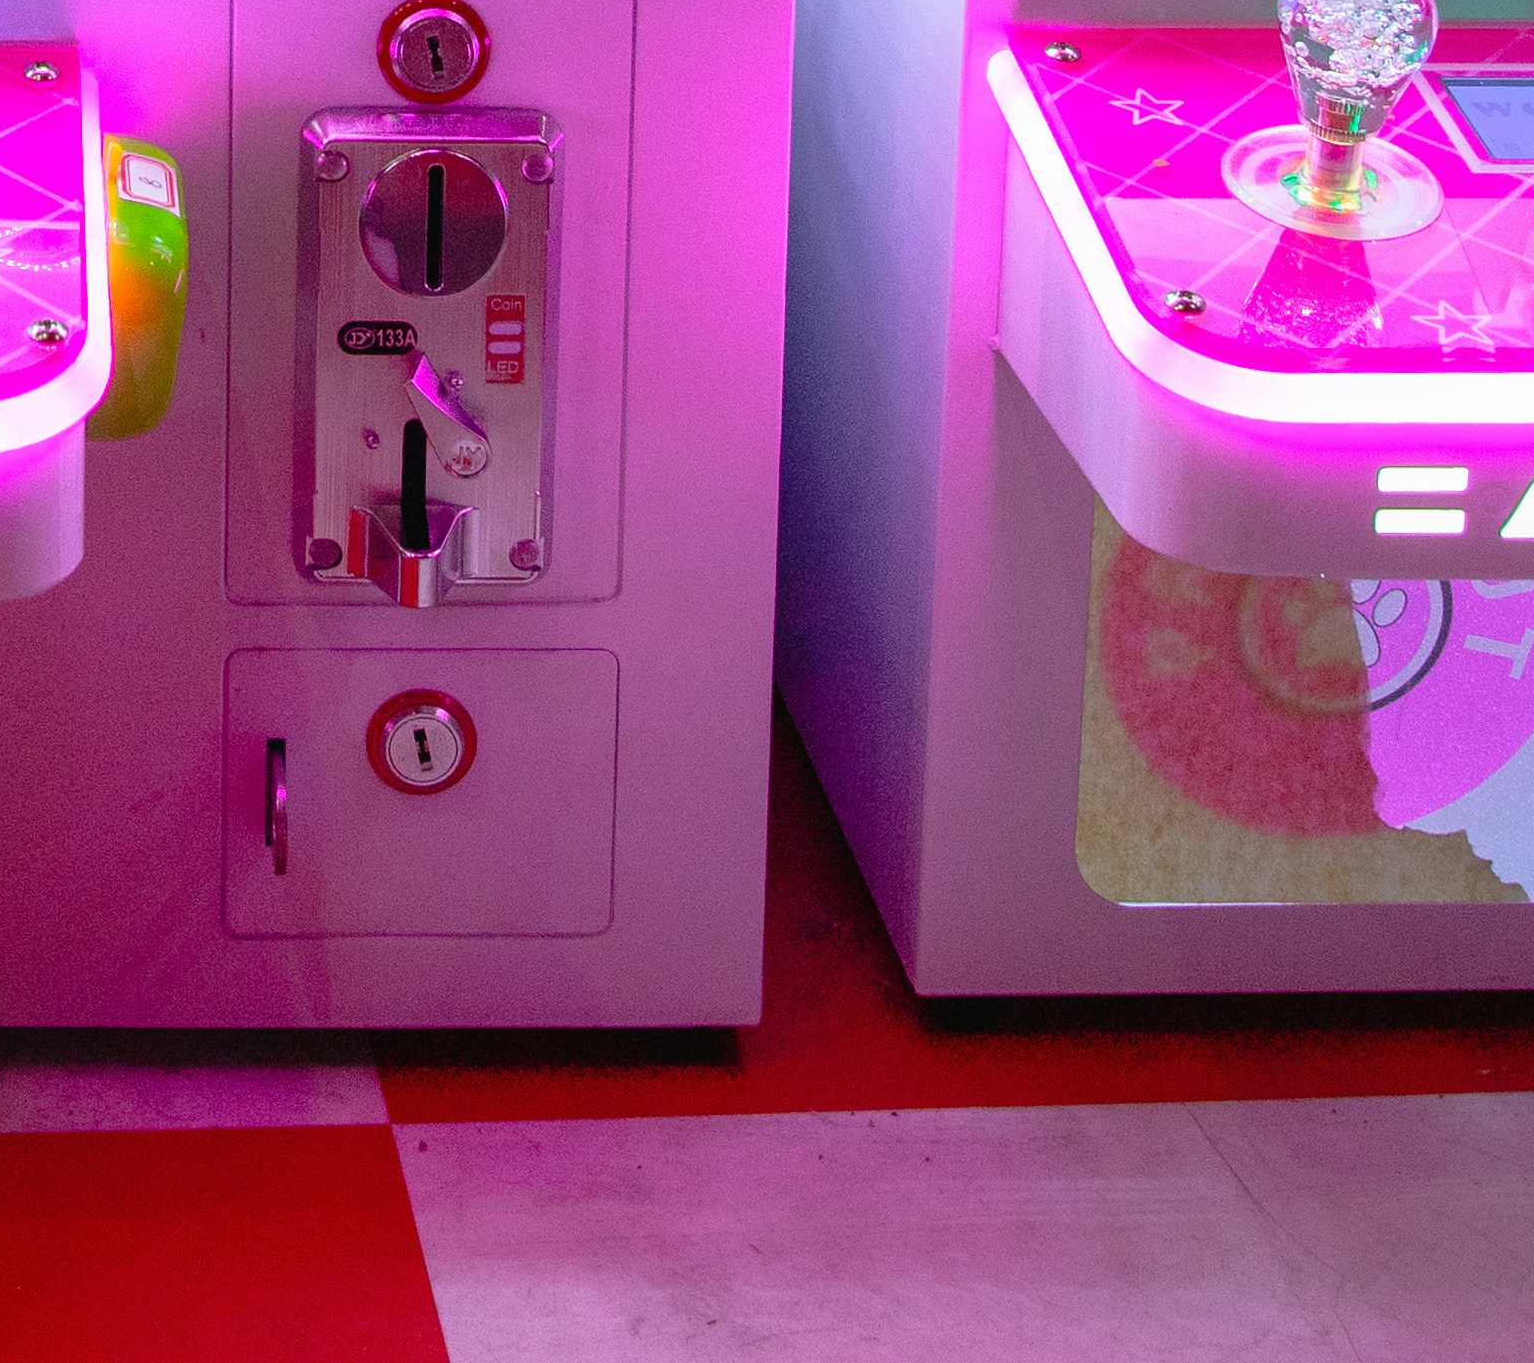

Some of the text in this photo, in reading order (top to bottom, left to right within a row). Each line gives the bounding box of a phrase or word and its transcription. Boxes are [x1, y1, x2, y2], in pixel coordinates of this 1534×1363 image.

[490, 297, 522, 312] Coin
[376, 330, 416, 348] 133A
[487, 359, 520, 374] LED
